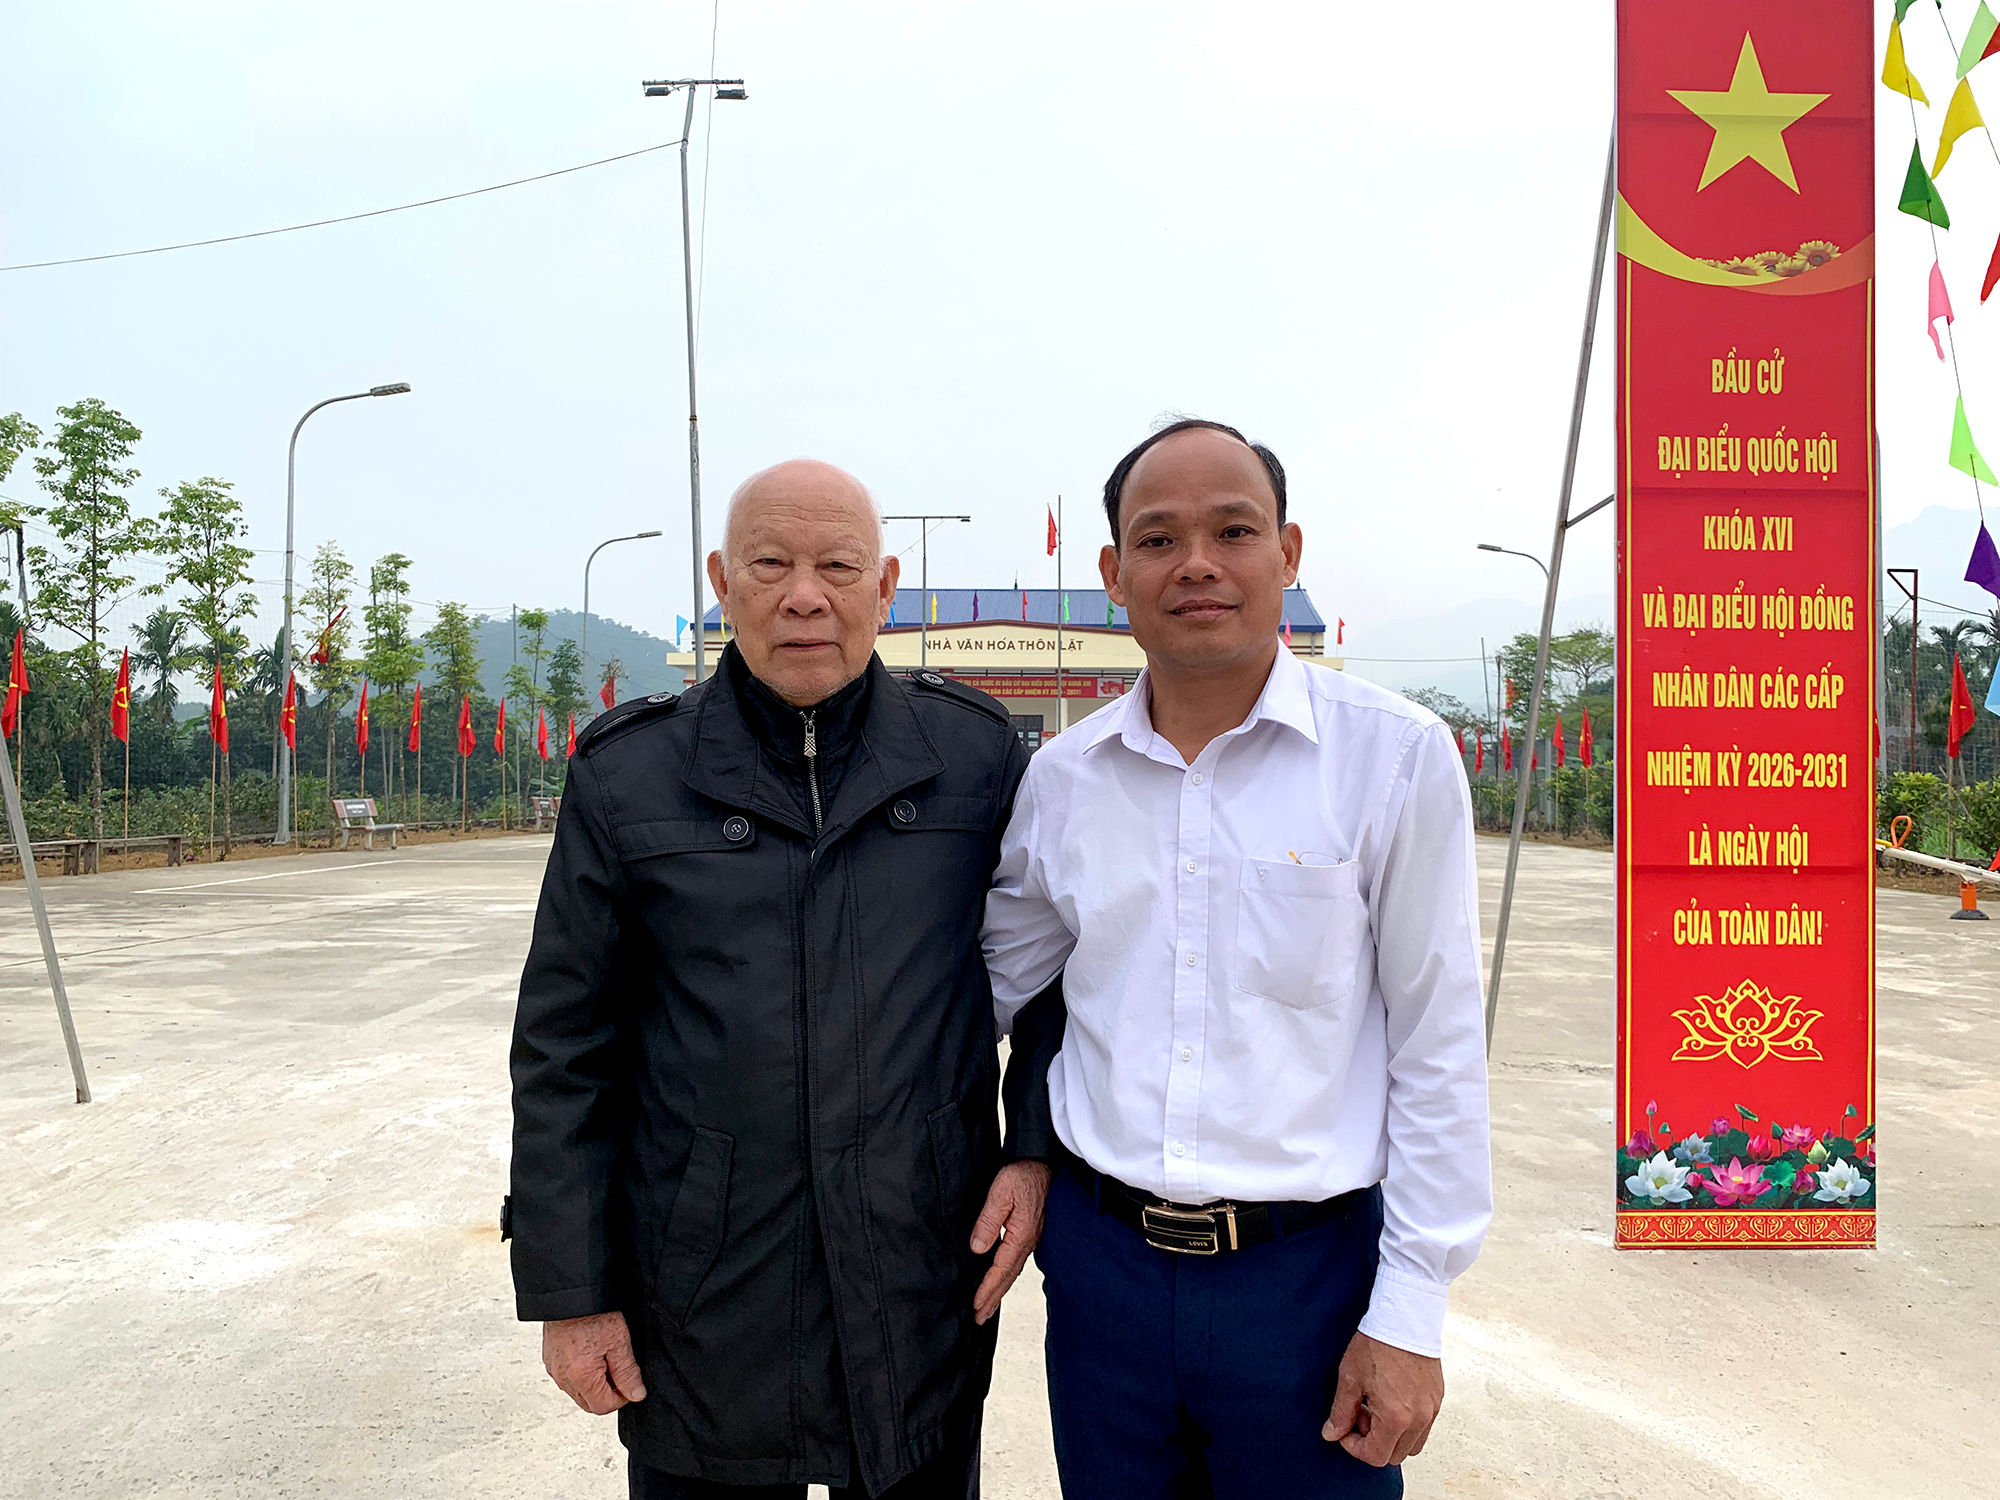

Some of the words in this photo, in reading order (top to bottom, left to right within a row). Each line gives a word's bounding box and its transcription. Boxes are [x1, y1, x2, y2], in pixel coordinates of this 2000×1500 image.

[1711, 346, 1751, 394] BẦU
[1756, 347, 1785, 395] CỬ
[1657, 435, 1691, 479] ĐẠI
[1696, 422, 1741, 473] BIỂU
[1747, 425, 1799, 477] QUỐC
[1804, 431, 1838, 482] HỘI
[1703, 508, 1757, 551] KHÓA
[1761, 516, 1793, 551] XVI
[1642, 585, 1668, 628] VÀ
[1672, 593, 1706, 637] ĐẠI
[1711, 579, 1756, 630] BIỂU
[1762, 587, 1795, 638] HỘI
[1799, 583, 1854, 631] ĐỒNG
[925, 637, 952, 650] NHÀ
[957, 638, 983, 651] VĂN
[987, 636, 1016, 651] HÓA
[1018, 638, 1056, 651] THÔN
[1652, 664, 1709, 708] NHÂN
[1713, 665, 1754, 708] DÂN
[1760, 666, 1799, 709] CÁC
[1805, 661, 1844, 709] CẤP
[1647, 743, 1711, 795] NHIỆM
[1717, 744, 1742, 787] KỲ
[1747, 752, 1847, 788] 2026-2031
[1688, 822, 1713, 866] LÀ
[1718, 823, 1771, 867] NGÀY
[1776, 823, 1809, 875] HỘI
[1673, 897, 1713, 946] CỦA
[1718, 902, 1770, 946] TOÀN
[1775, 902, 1823, 946] DÂN!
